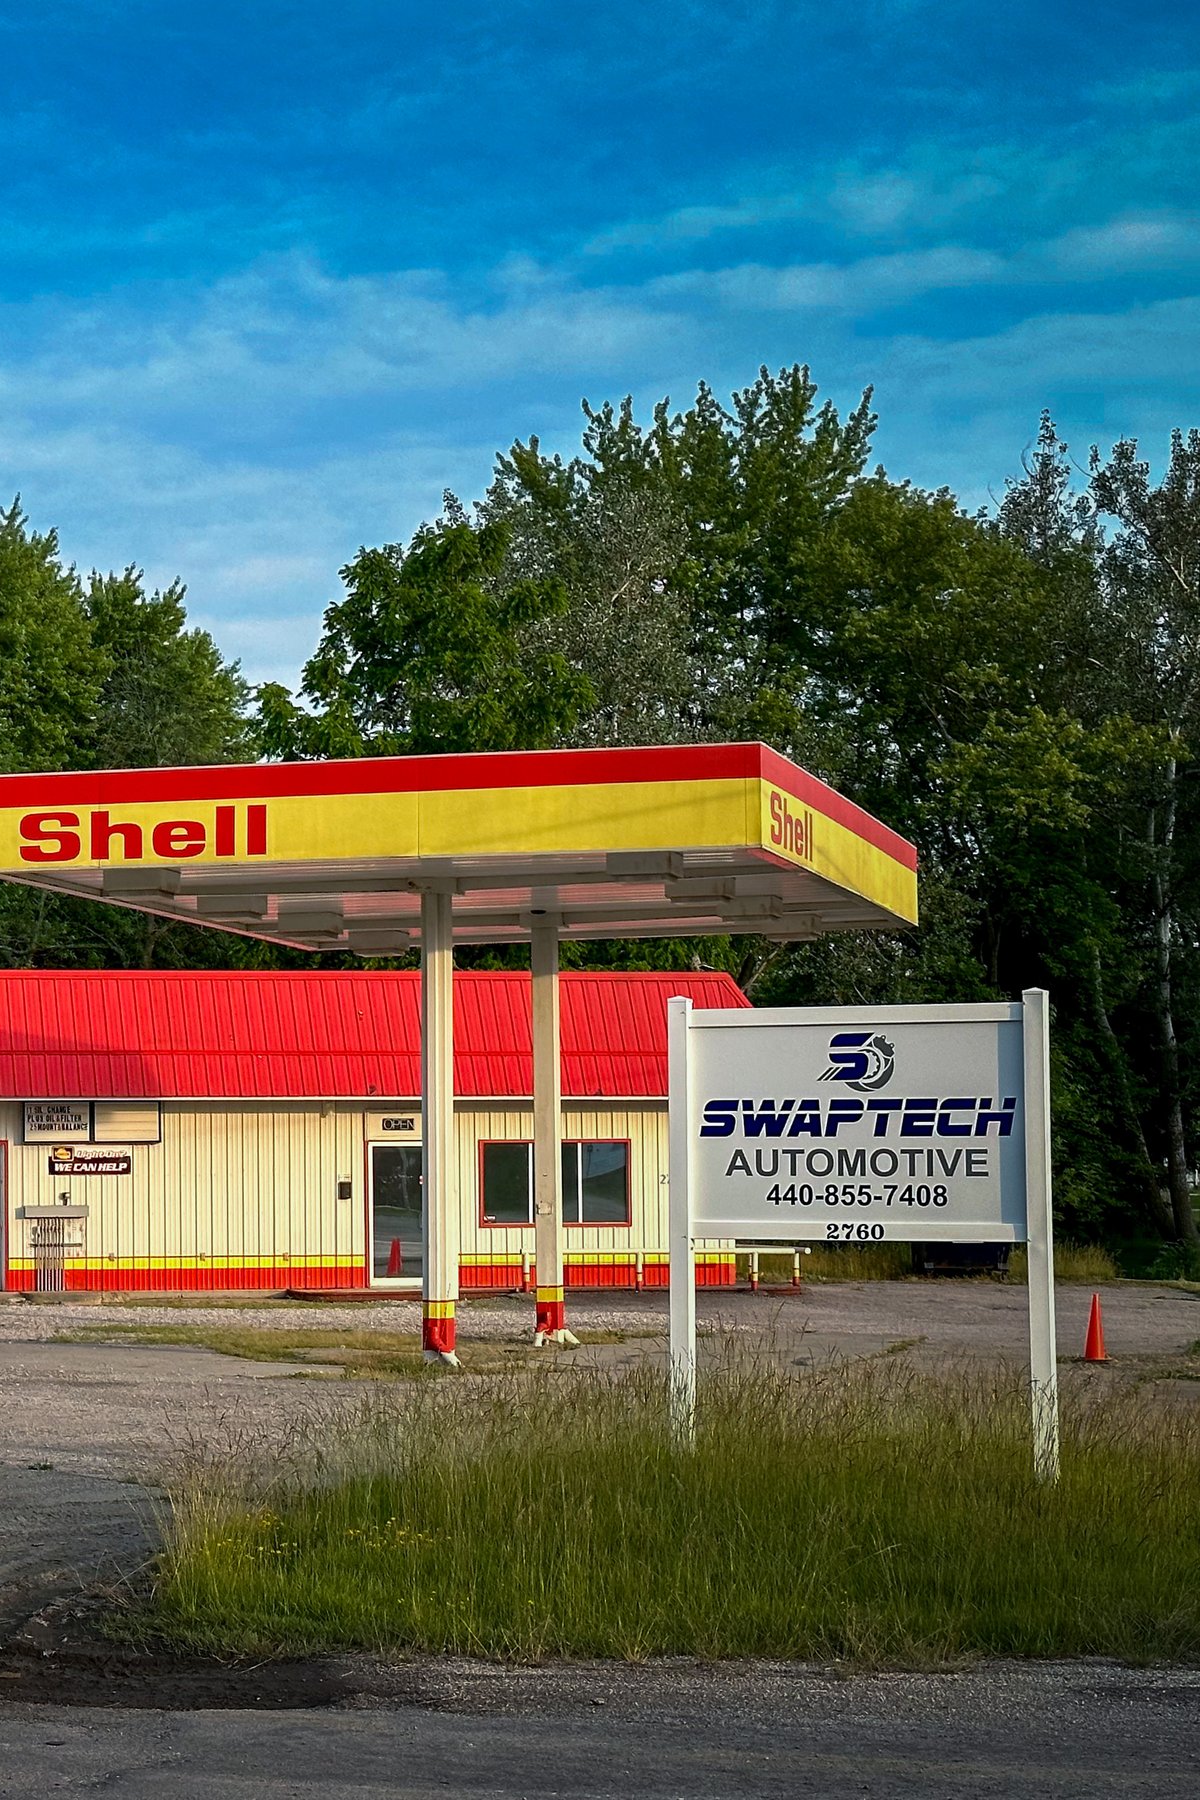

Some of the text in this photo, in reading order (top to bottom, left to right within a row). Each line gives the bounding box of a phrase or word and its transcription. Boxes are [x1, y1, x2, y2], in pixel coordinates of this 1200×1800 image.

[19, 804, 267, 862] Shell
[770, 790, 813, 862] Shell
[27, 1114, 44, 1122] PLUS
[47, 1105, 71, 1114] CHANGE
[699, 1097, 1017, 1138] SWAPTECH
[383, 1119, 415, 1130] OPEN
[54, 1162, 128, 1171] WE CAN HELP
[725, 1149, 990, 1178] AUTOMOTIVE
[766, 1184, 948, 1207] 440-855-7408
[826, 1223, 885, 1240] 2760
